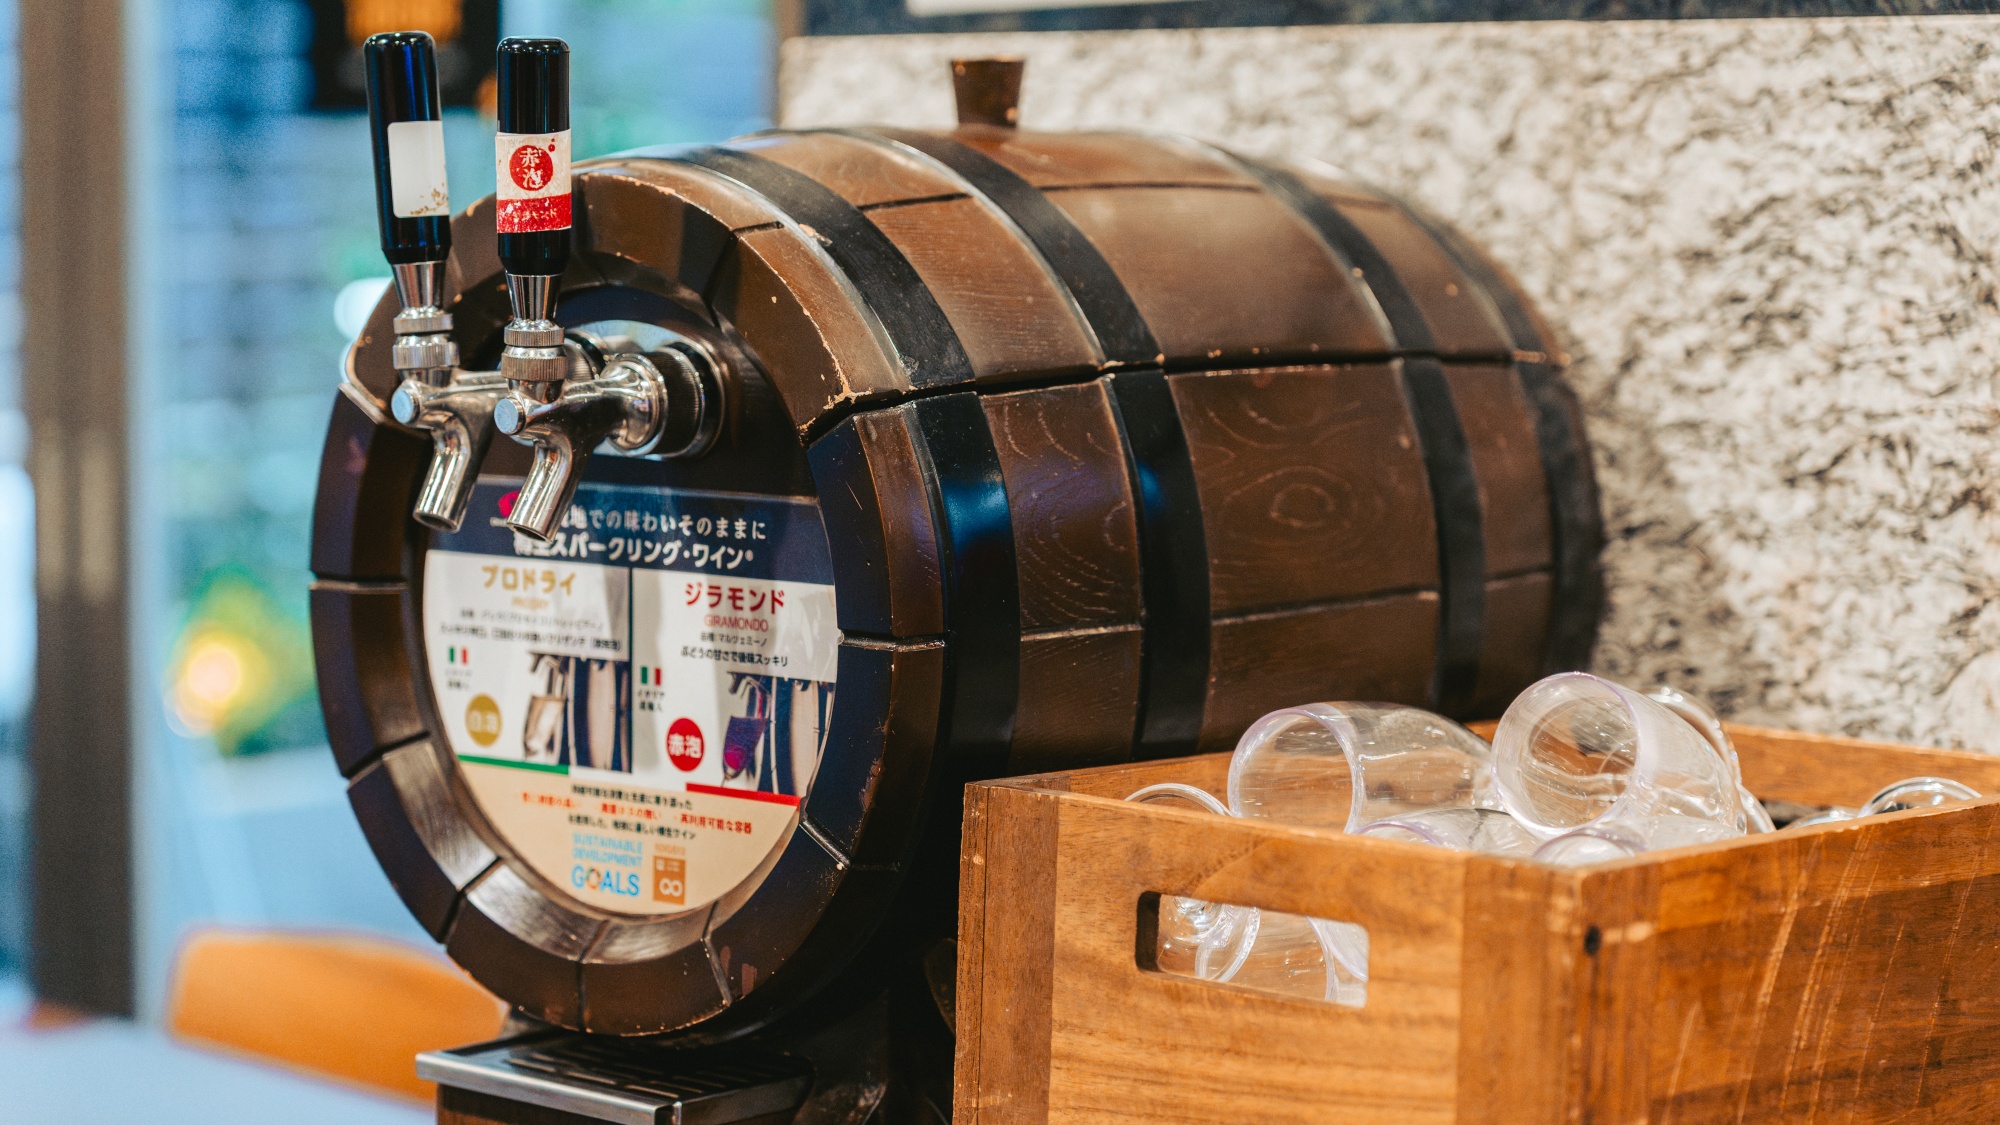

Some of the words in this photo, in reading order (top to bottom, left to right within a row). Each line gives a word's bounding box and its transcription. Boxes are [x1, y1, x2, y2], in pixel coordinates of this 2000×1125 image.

[684, 581, 785, 615] ジラモンド
[704, 613, 769, 633] GIRAMONDO
[668, 732, 702, 759] 赤泡
[573, 832, 644, 855] SUSTAINABLE
[573, 847, 644, 868] DEVELOPMENT
[571, 863, 640, 898] GOALS
